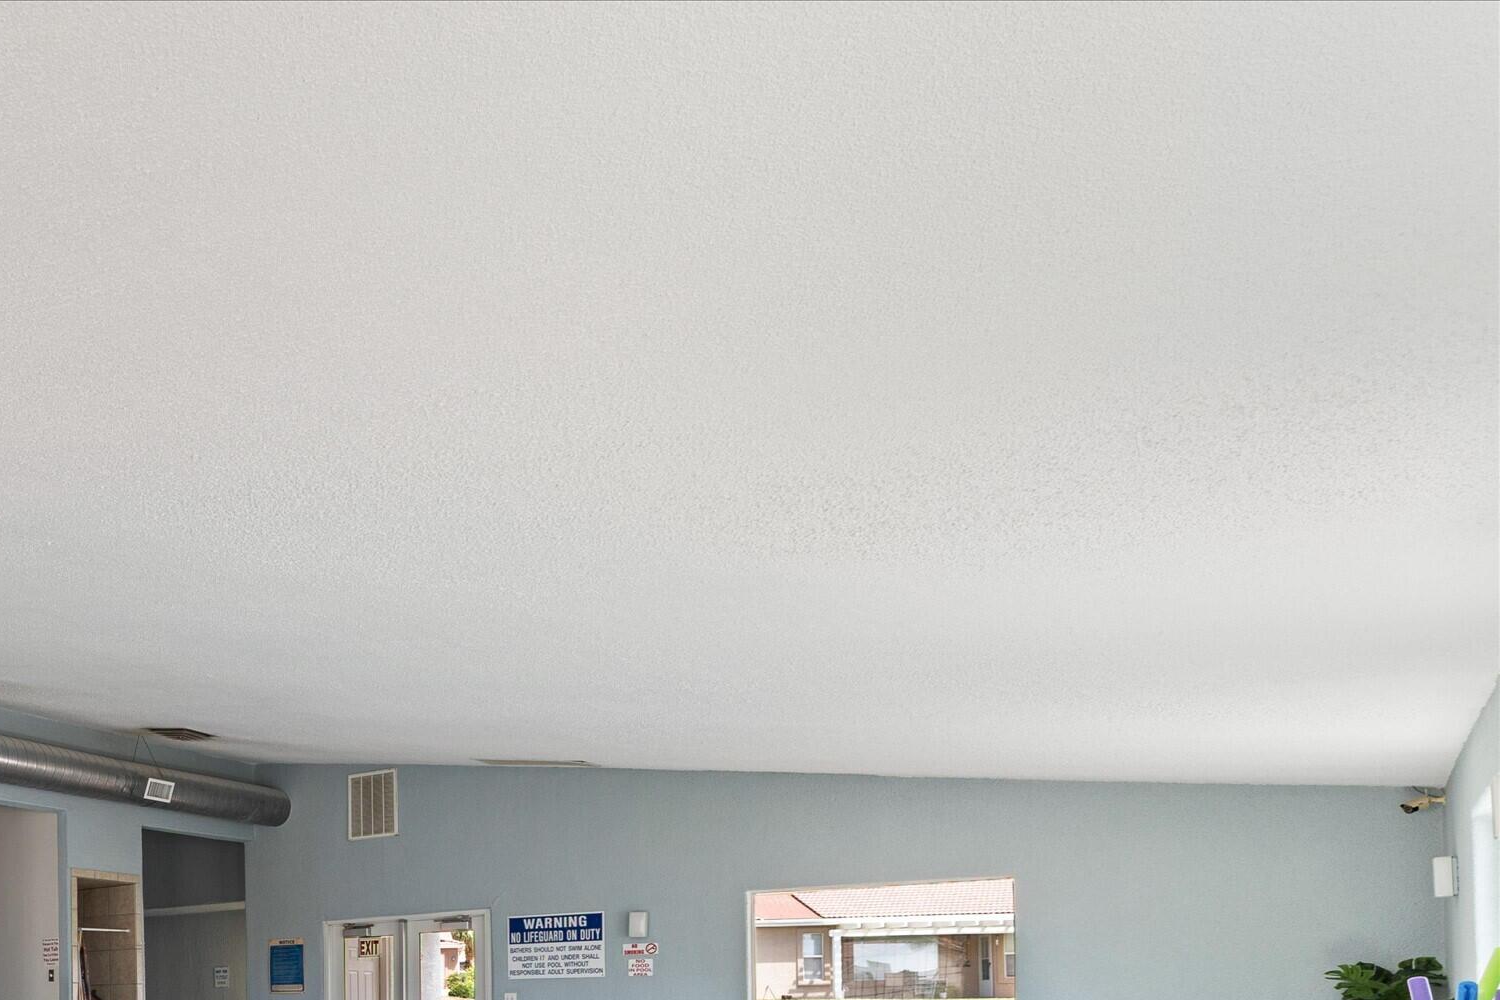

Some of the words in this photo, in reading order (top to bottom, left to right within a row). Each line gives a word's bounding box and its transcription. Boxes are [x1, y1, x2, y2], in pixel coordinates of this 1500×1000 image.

[523, 915, 587, 929] WARNING
[511, 931, 520, 943] NO
[523, 930, 563, 943] LIFEGUARD
[566, 929, 577, 941] ON
[580, 928, 601, 940] DUTY
[360, 940, 379, 955] EXIT
